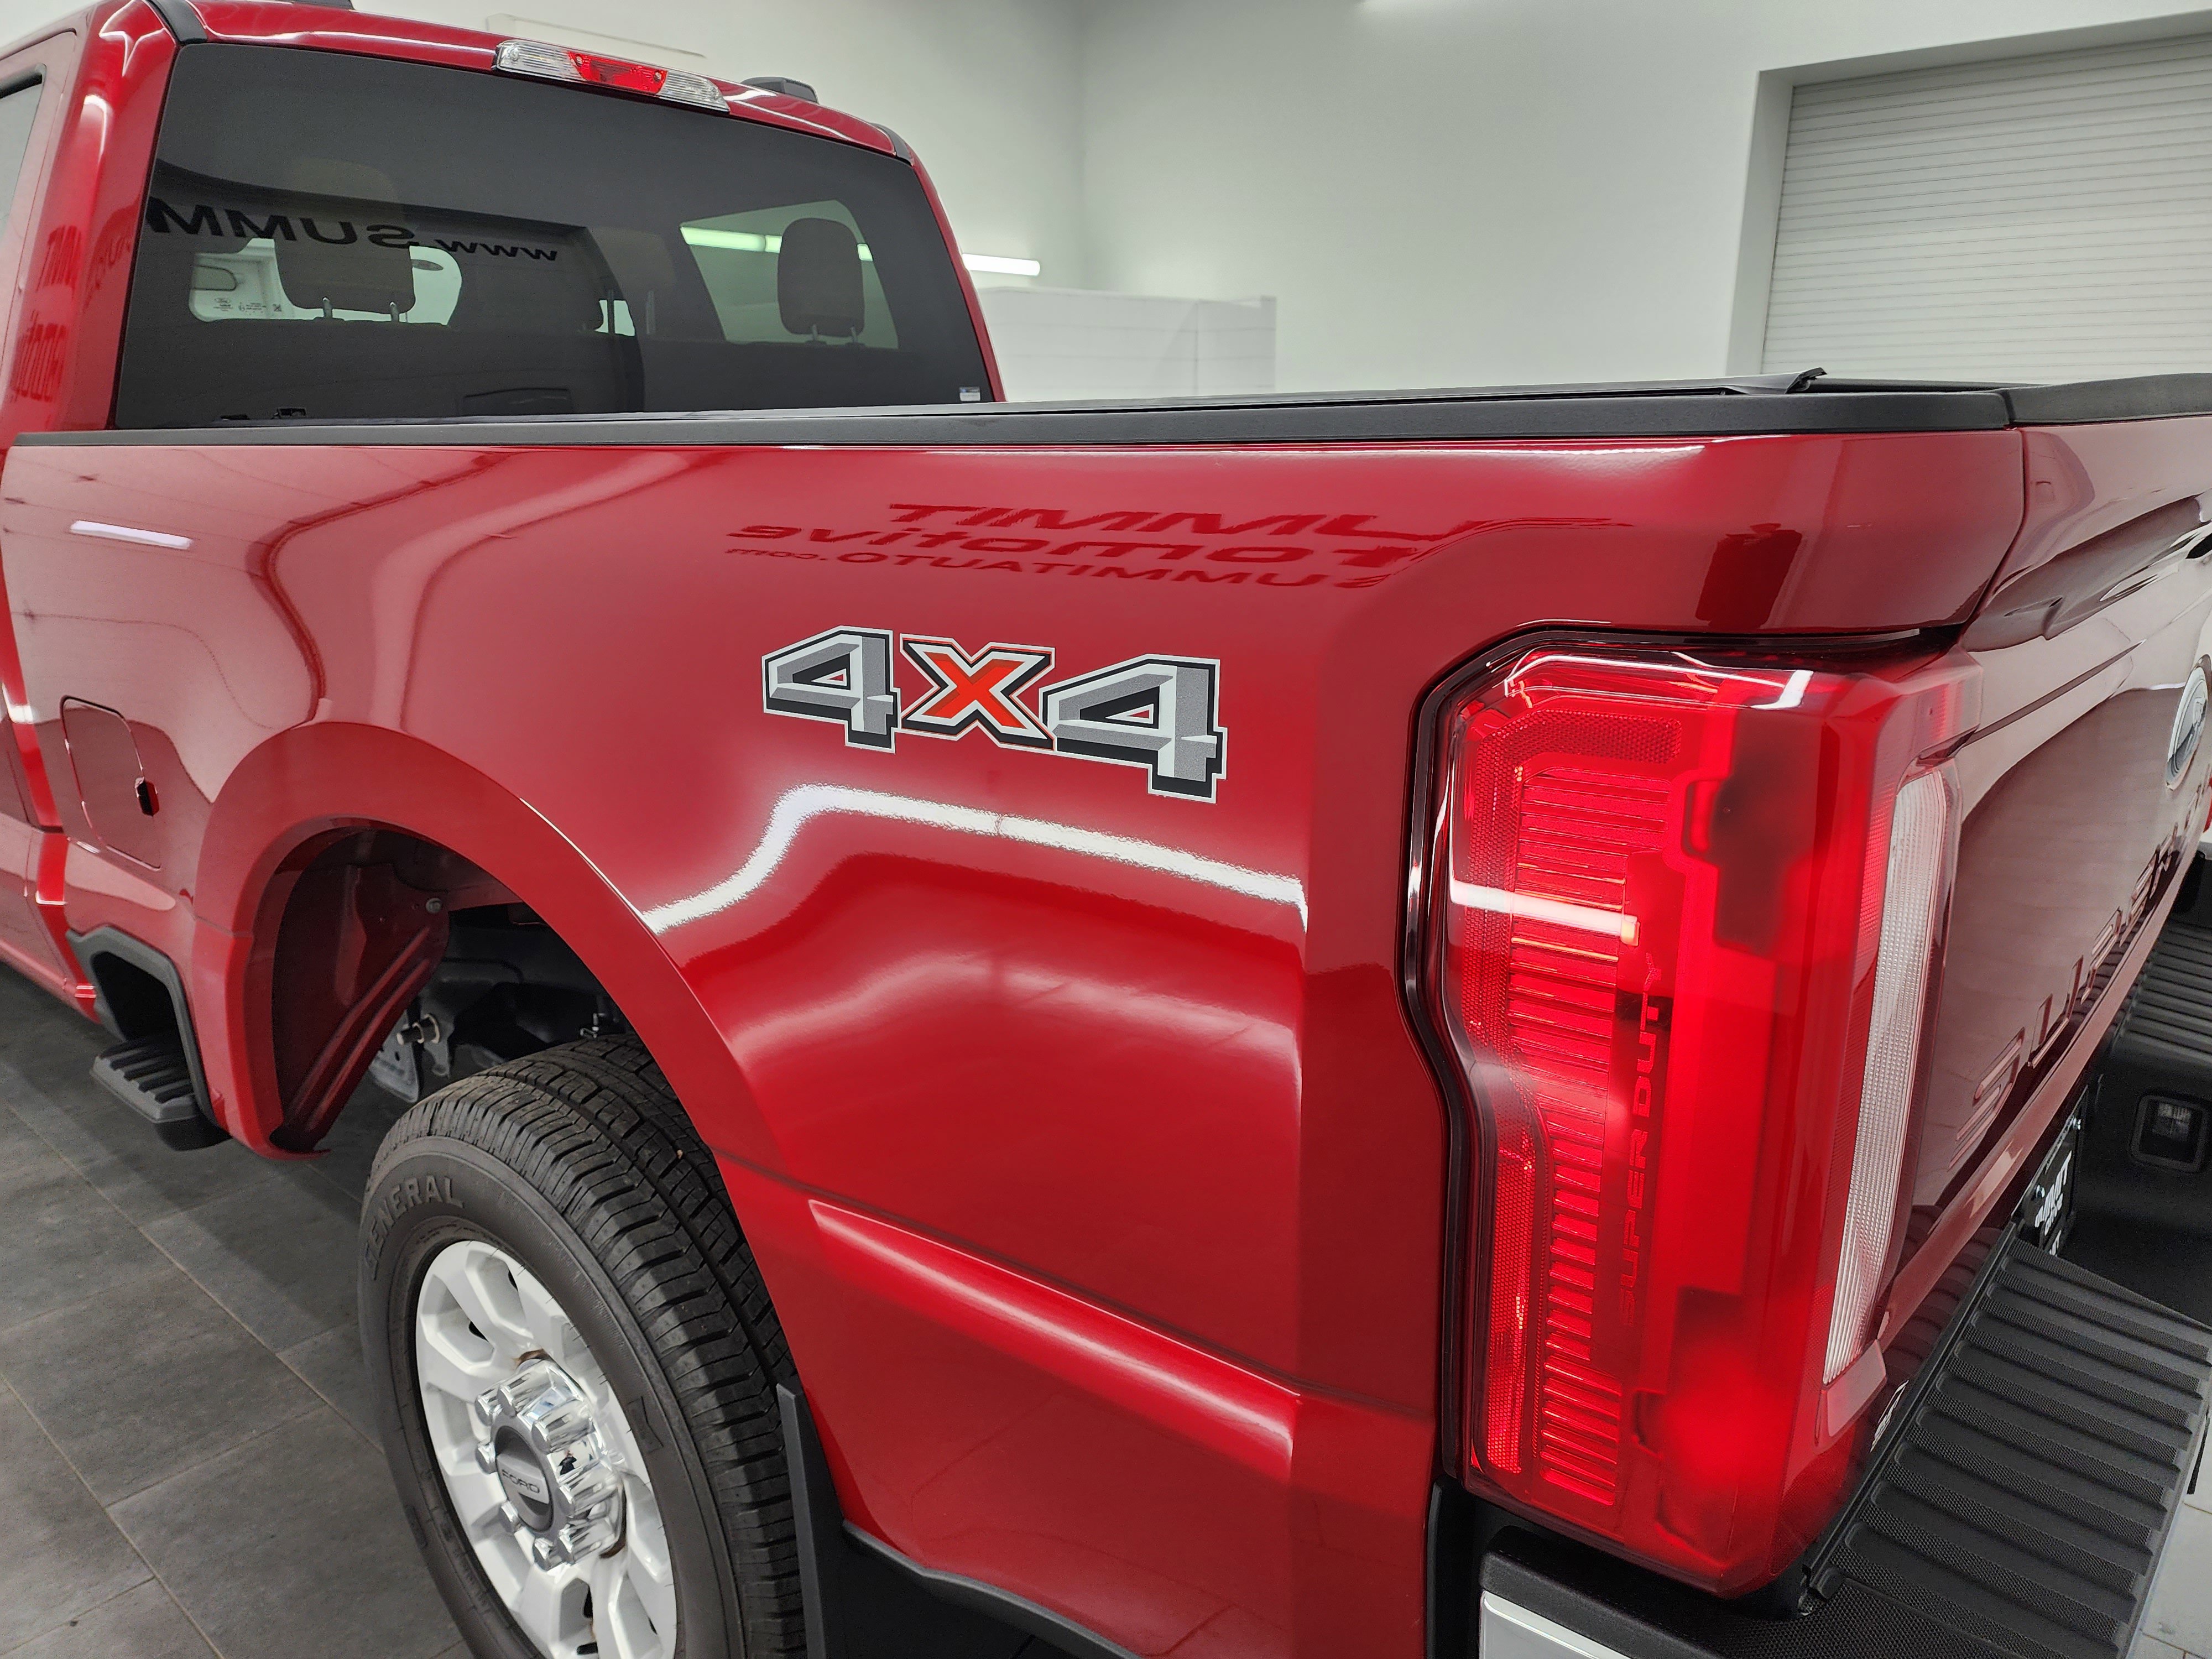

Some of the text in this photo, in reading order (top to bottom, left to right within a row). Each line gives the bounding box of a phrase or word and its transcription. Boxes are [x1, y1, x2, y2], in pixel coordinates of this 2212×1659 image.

[1619, 952, 1662, 1327] SUPER DUTY
[501, 1469, 540, 1494] FORD
